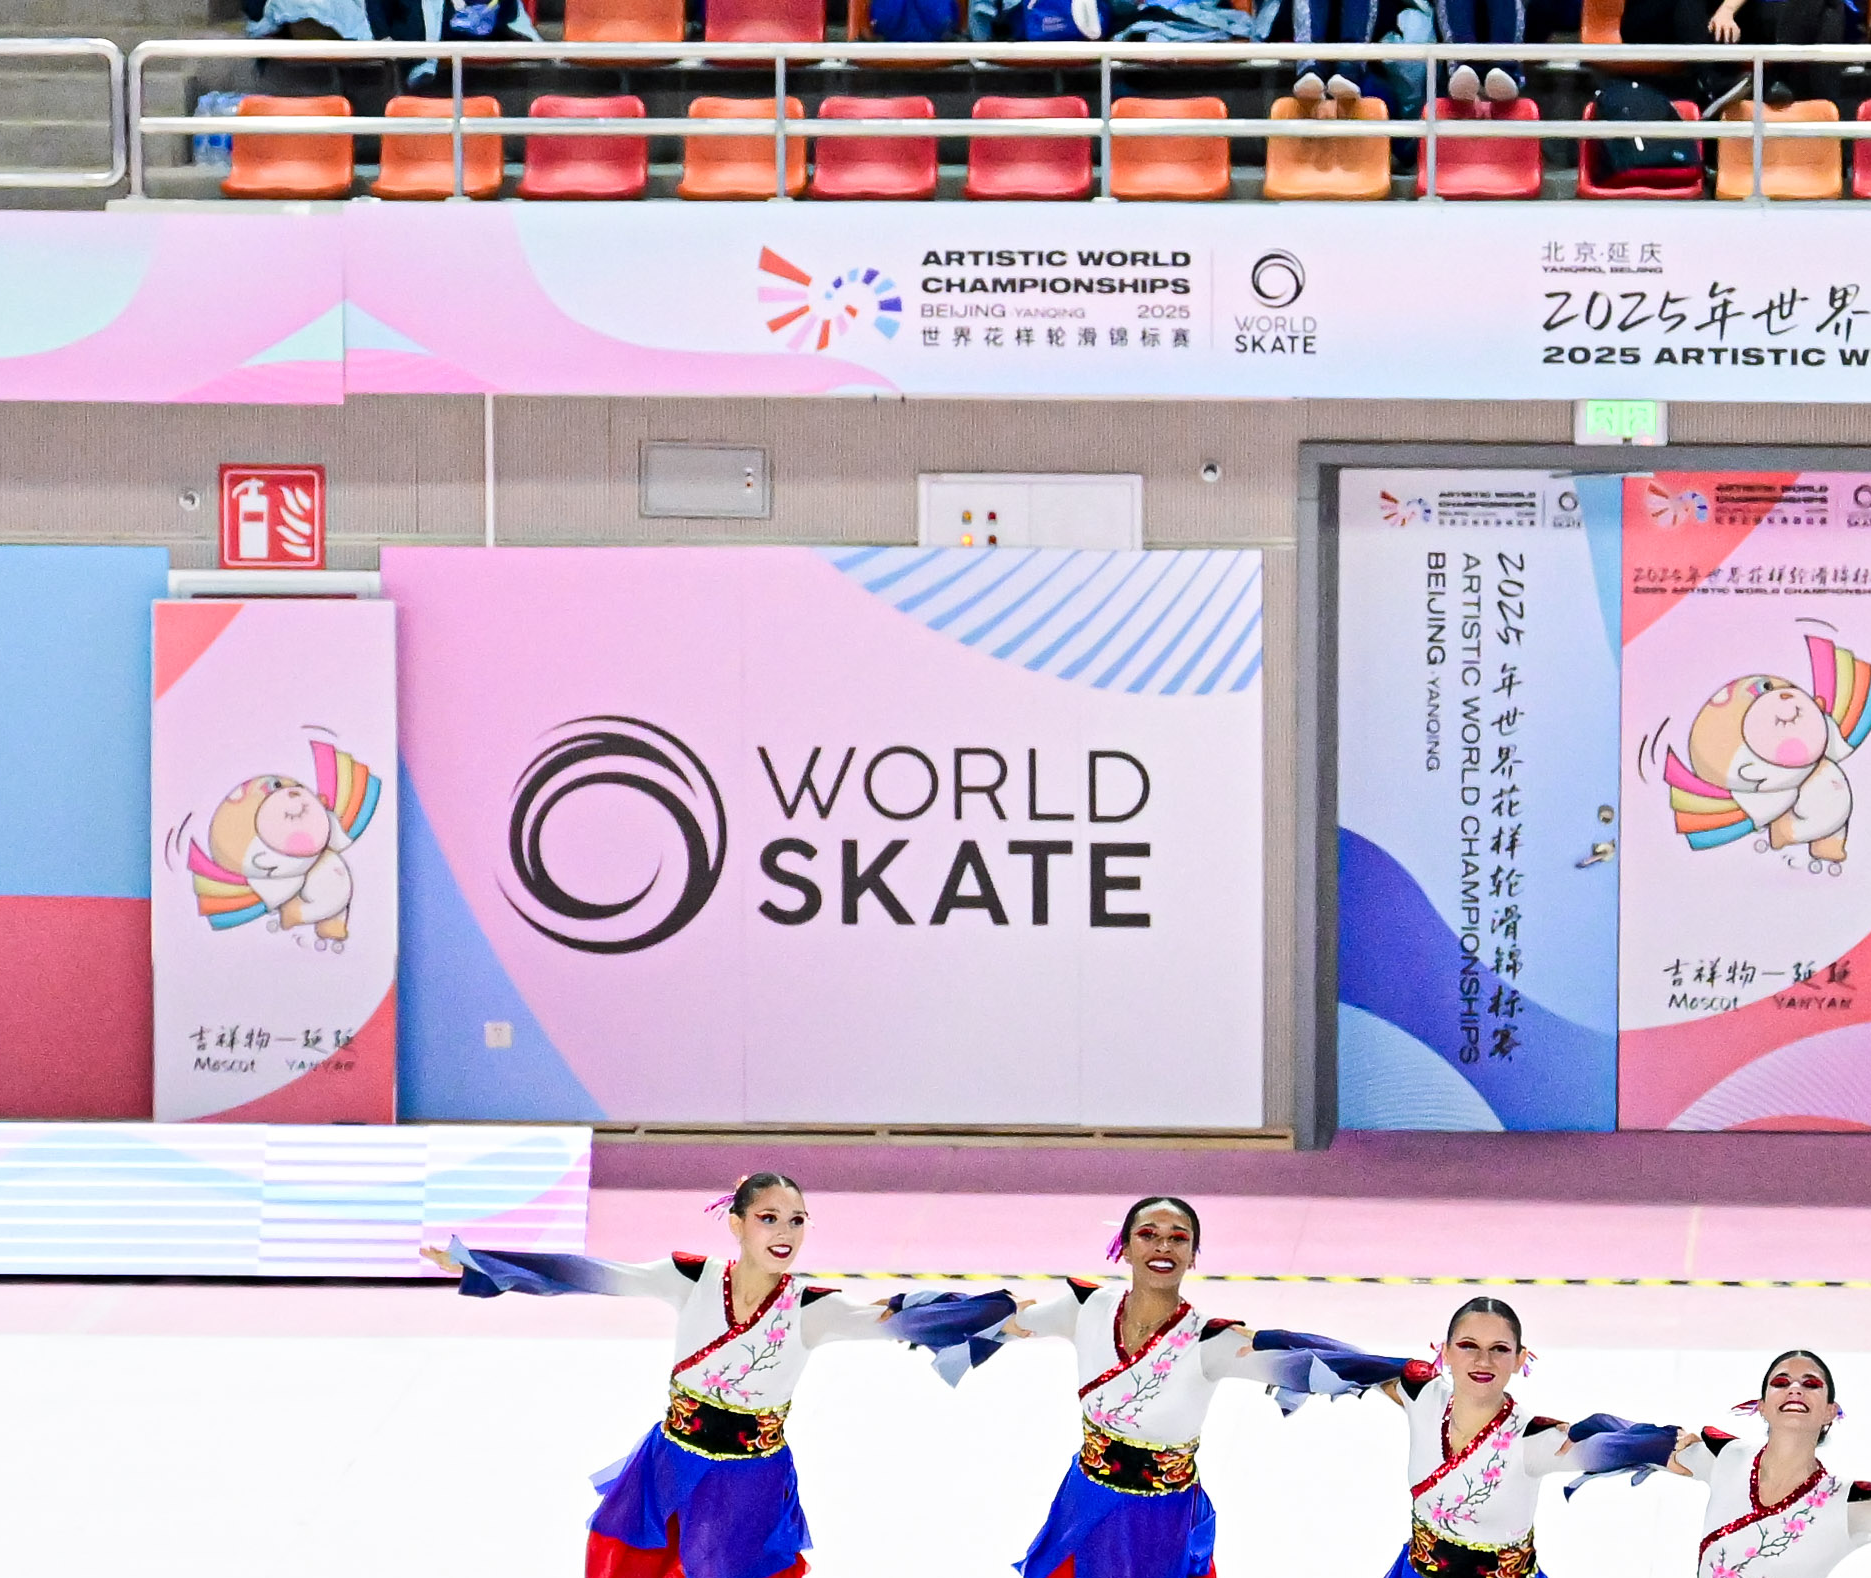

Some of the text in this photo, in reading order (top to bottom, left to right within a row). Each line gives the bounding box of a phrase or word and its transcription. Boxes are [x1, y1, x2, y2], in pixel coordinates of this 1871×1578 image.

[922, 250, 1191, 267] ARTISTIC WORLD
[921, 277, 1191, 295] CHAMPIONSHIPS
[920, 303, 1006, 318] BEIJING
[1137, 304, 1191, 319] 2025
[1234, 315, 1317, 334] WORLD
[921, 326, 1191, 349] 世界花样轮滑锦标赛
[1234, 334, 1317, 354] SKATE
[1542, 346, 1642, 366] 2025
[1654, 347, 1827, 367] ARTISTIC
[1426, 551, 1447, 666] BEIJING
[757, 745, 1151, 824] WORLD
[1459, 552, 1481, 1065] ARTISTIC WORLD CHAMPIONSHIPS
[758, 838, 1152, 928] SKATE
